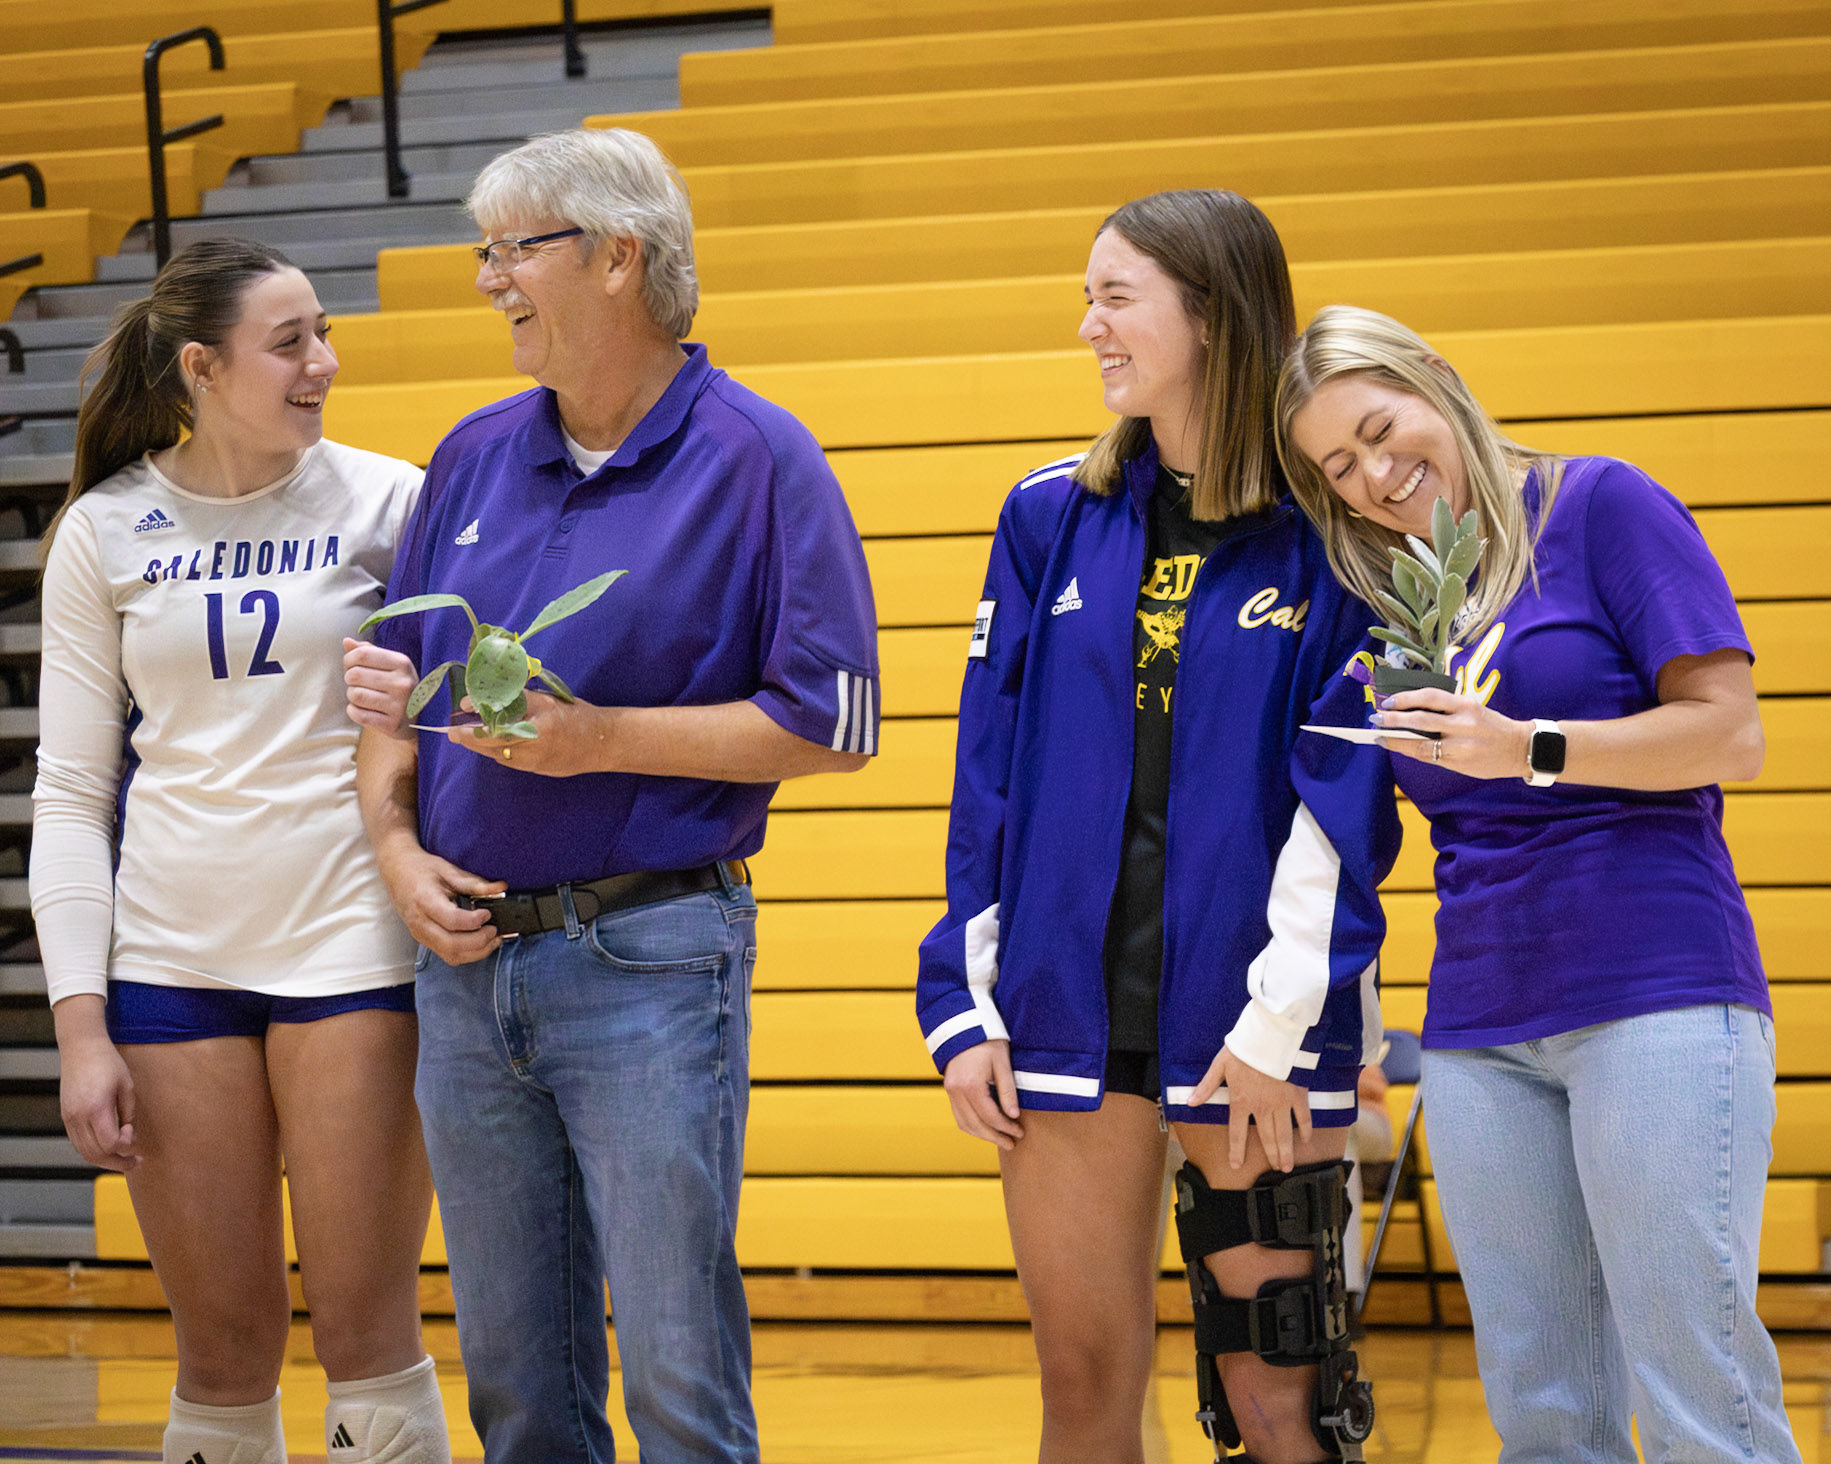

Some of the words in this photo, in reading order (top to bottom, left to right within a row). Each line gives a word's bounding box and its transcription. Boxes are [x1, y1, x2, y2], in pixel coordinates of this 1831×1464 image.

[134, 520, 175, 533] adidas
[143, 536, 339, 585] CALEDONIA
[1139, 554, 1209, 601] ED
[1051, 599, 1083, 616] adidas
[1237, 586, 1310, 633] Cal
[204, 589, 286, 680] 12
